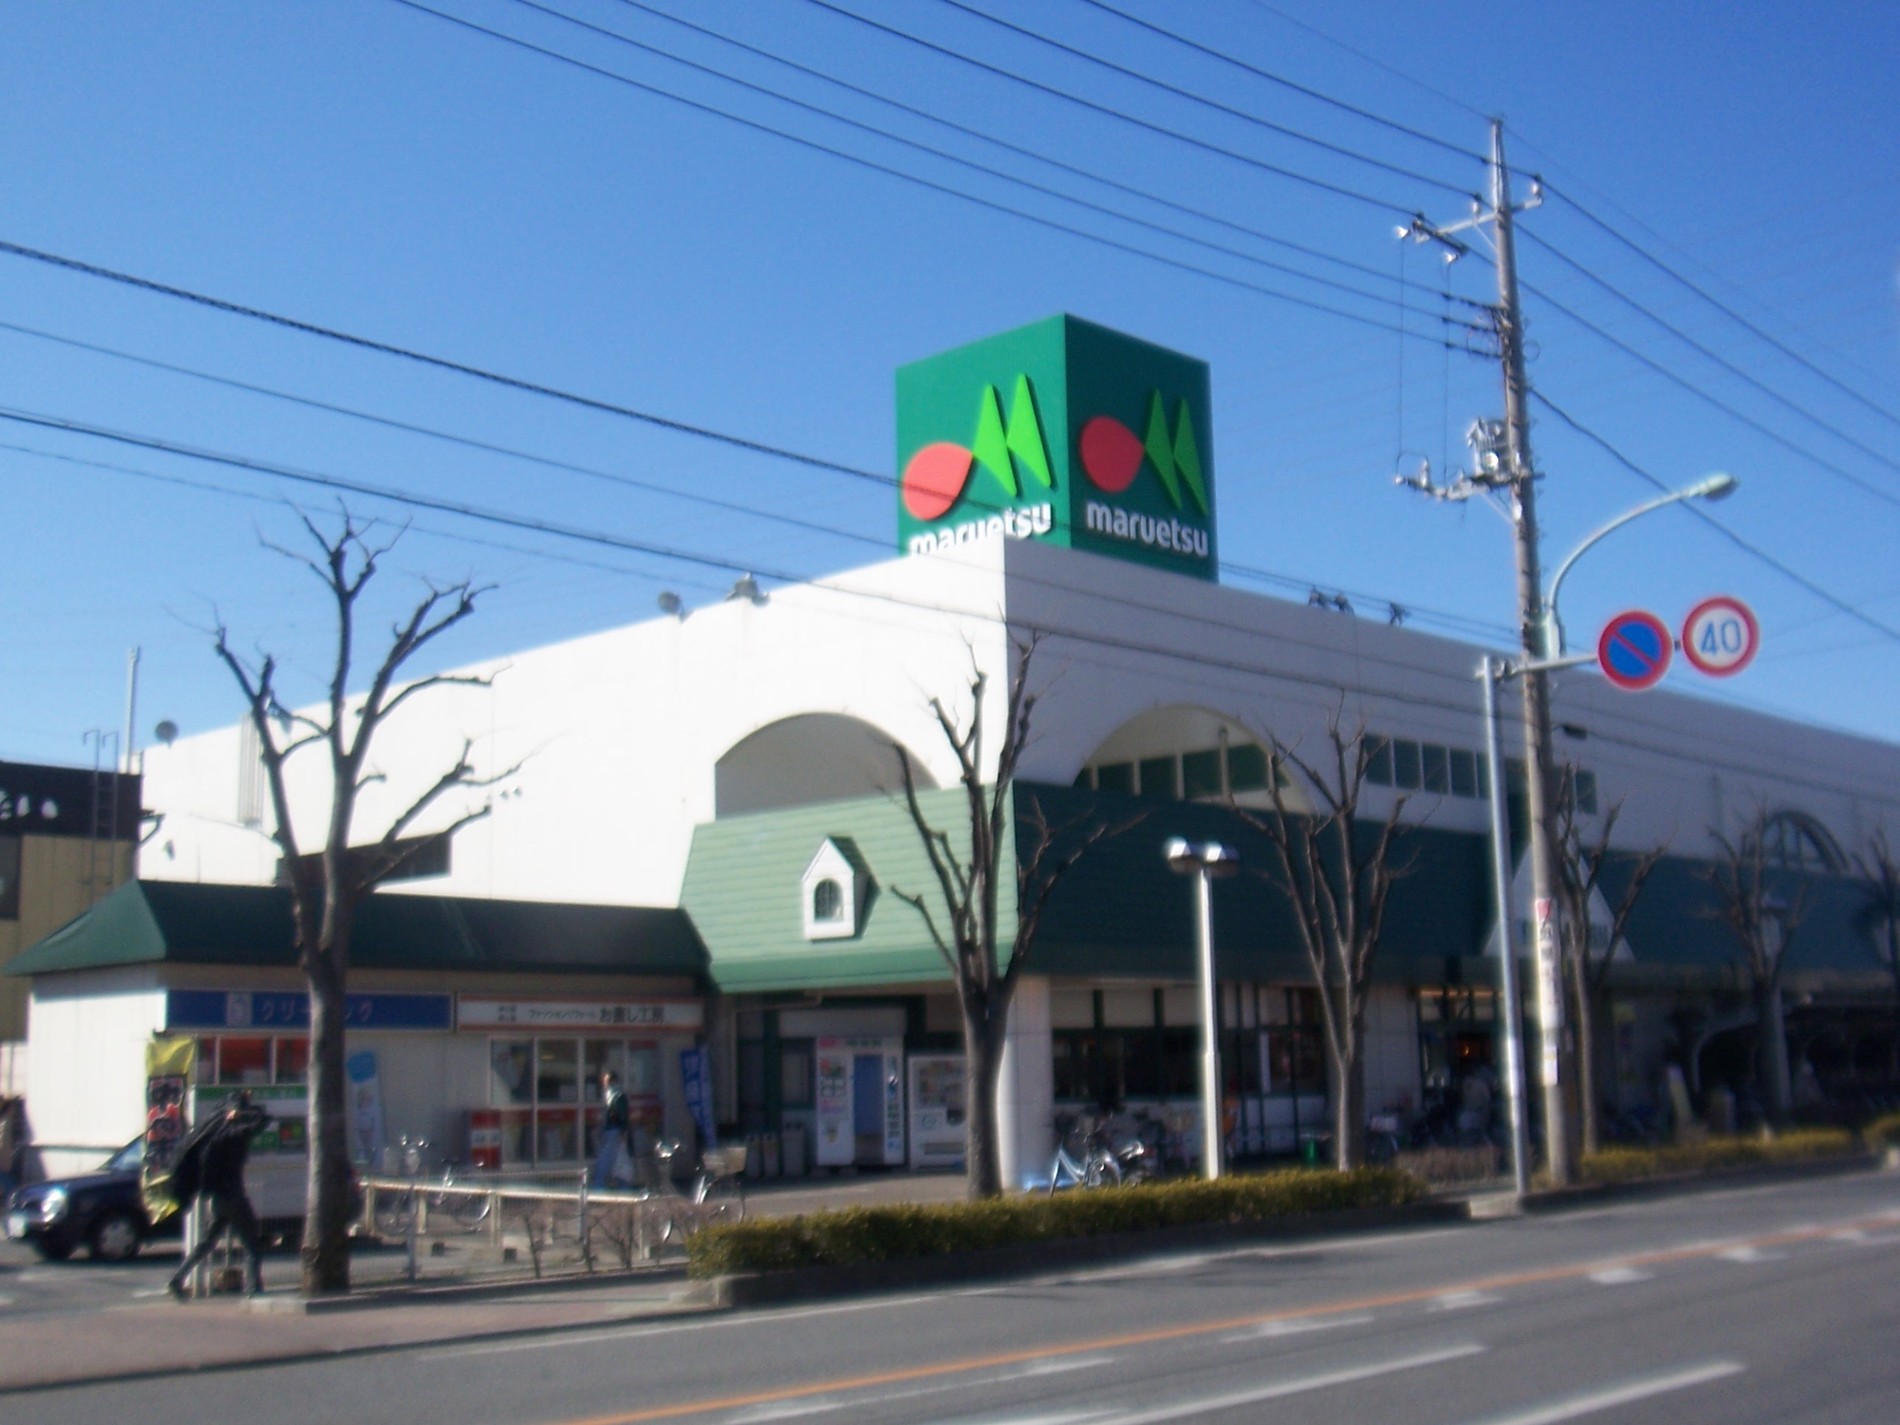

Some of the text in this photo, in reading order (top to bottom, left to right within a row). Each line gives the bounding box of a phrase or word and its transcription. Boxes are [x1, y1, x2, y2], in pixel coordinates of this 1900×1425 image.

[909, 502, 1052, 556] maruetsu
[1086, 502, 1208, 557] maruetsu
[1701, 619, 1742, 655] 40
